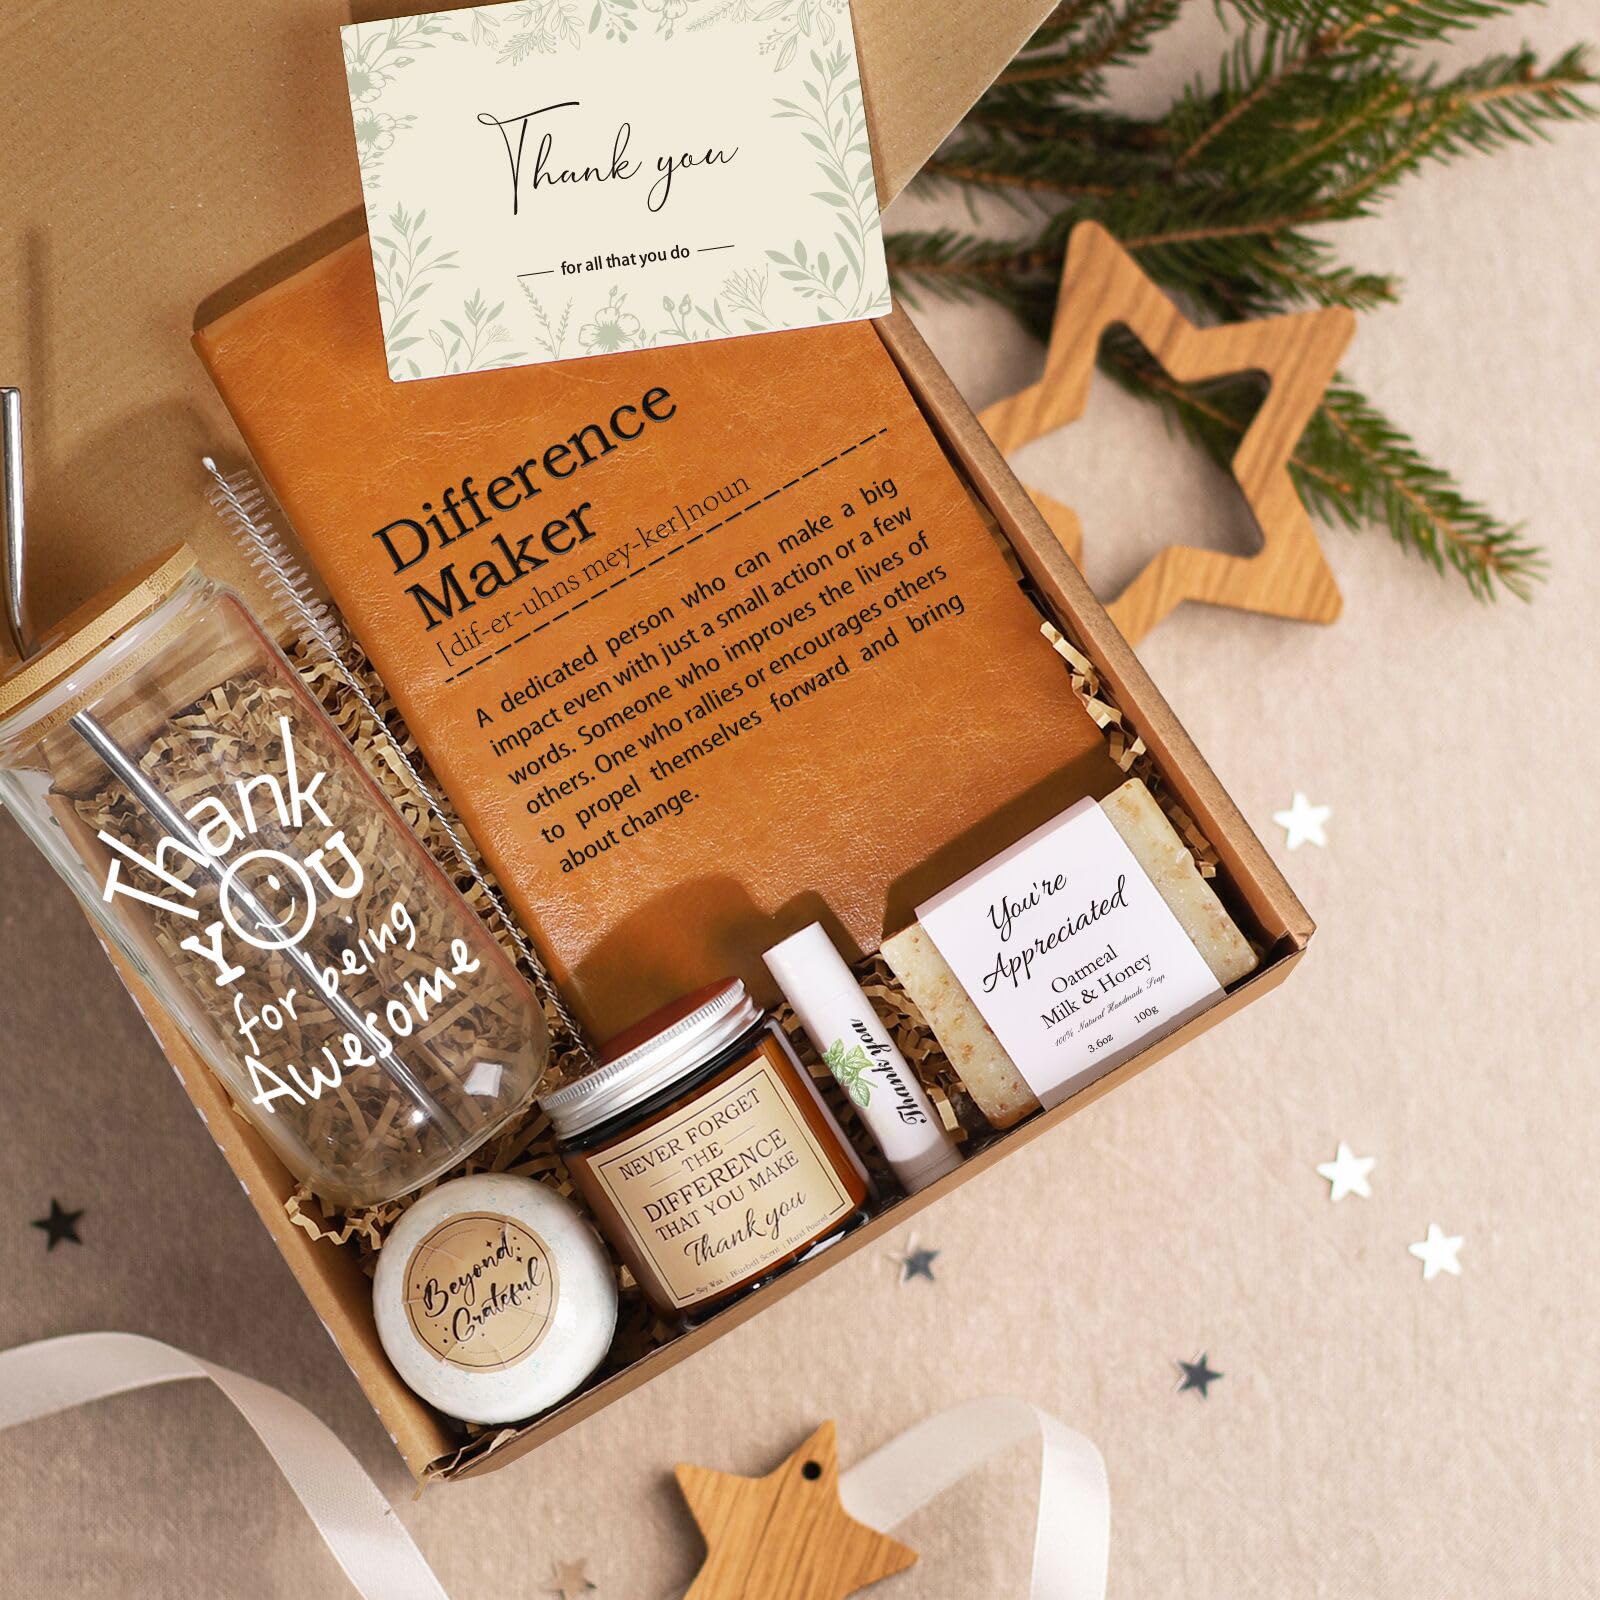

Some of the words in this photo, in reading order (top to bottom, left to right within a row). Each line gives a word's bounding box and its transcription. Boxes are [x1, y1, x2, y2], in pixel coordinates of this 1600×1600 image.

[477, 101, 643, 215] Thank
[647, 146, 739, 212] you
[561, 260, 583, 276] for
[585, 255, 603, 272] all
[605, 252, 637, 269] that
[639, 251, 668, 270] you
[669, 245, 690, 262] do
[372, 386, 677, 576] Difference
[404, 502, 597, 632] Maker
[476, 708, 494, 728] A
[500, 645, 599, 713] dedicated
[605, 605, 675, 653] person
[681, 576, 726, 609] who
[734, 551, 771, 578] can
[777, 514, 834, 554] make
[843, 503, 856, 517] a
[860, 477, 898, 505] big
[436, 574, 580, 667] [dif-er-uhns
[490, 708, 562, 757] impact
[563, 680, 612, 715] even
[613, 651, 660, 686] with
[658, 627, 700, 665] just
[702, 622, 715, 637] a
[716, 584, 770, 628] small
[771, 552, 834, 597] action
[835, 537, 856, 560] or
[861, 531, 873, 545] a
[873, 505, 912, 537] few
[508, 742, 577, 785] words.
[577, 684, 673, 746] Someone
[675, 656, 720, 690] who
[721, 601, 816, 662] improves
[818, 578, 855, 607] the
[855, 552, 904, 586] lives
[908, 530, 930, 556] of
[526, 768, 596, 814] others.
[594, 743, 638, 773] One
[639, 717, 683, 750] who
[685, 681, 744, 724] rallies
[745, 667, 766, 689] or
[769, 601, 882, 675] encourages
[884, 564, 947, 609] others
[540, 823, 565, 844] to
[575, 775, 642, 829] propel
[649, 709, 762, 782] themselves
[769, 655, 850, 712] forward
[860, 627, 900, 662] and
[906, 593, 965, 634] bring
[97, 716, 334, 920] Thank
[559, 828, 620, 873] about
[621, 788, 700, 838] change.
[180, 830, 364, 987] YOU
[983, 874, 1128, 993] Appreciated
[986, 874, 1067, 942] You're
[234, 988, 297, 1055] for
[303, 901, 416, 999] being
[1040, 999, 1080, 1029] Milk
[1081, 989, 1099, 1004] &
[1096, 954, 1152, 994] Honey
[1051, 944, 1119, 994] Oatmeal
[1077, 1012, 1105, 1033] Natural
[1107, 987, 1143, 1013] Handmade
[244, 938, 480, 1114] Awesome
[850, 1018, 892, 1056] you
[1088, 1033, 1114, 1053] 3.6oz
[1134, 1004, 1159, 1024] 100g
[618, 1139, 685, 1180] NEVER
[686, 1088, 761, 1145] FORGET
[871, 1059, 927, 1125] Thank
[643, 1128, 787, 1223] DIFFERENCE
[655, 1210, 702, 1241] THAT
[704, 1185, 745, 1218] YOU
[747, 1151, 799, 1193] MAKE
[681, 1140, 724, 1172] THE
[424, 1231, 514, 1318] Beyond
[684, 1208, 766, 1267] Thank
[766, 1191, 806, 1240] you
[453, 1257, 544, 1342] Grateful
[708, 1278, 724, 1291] Wax
